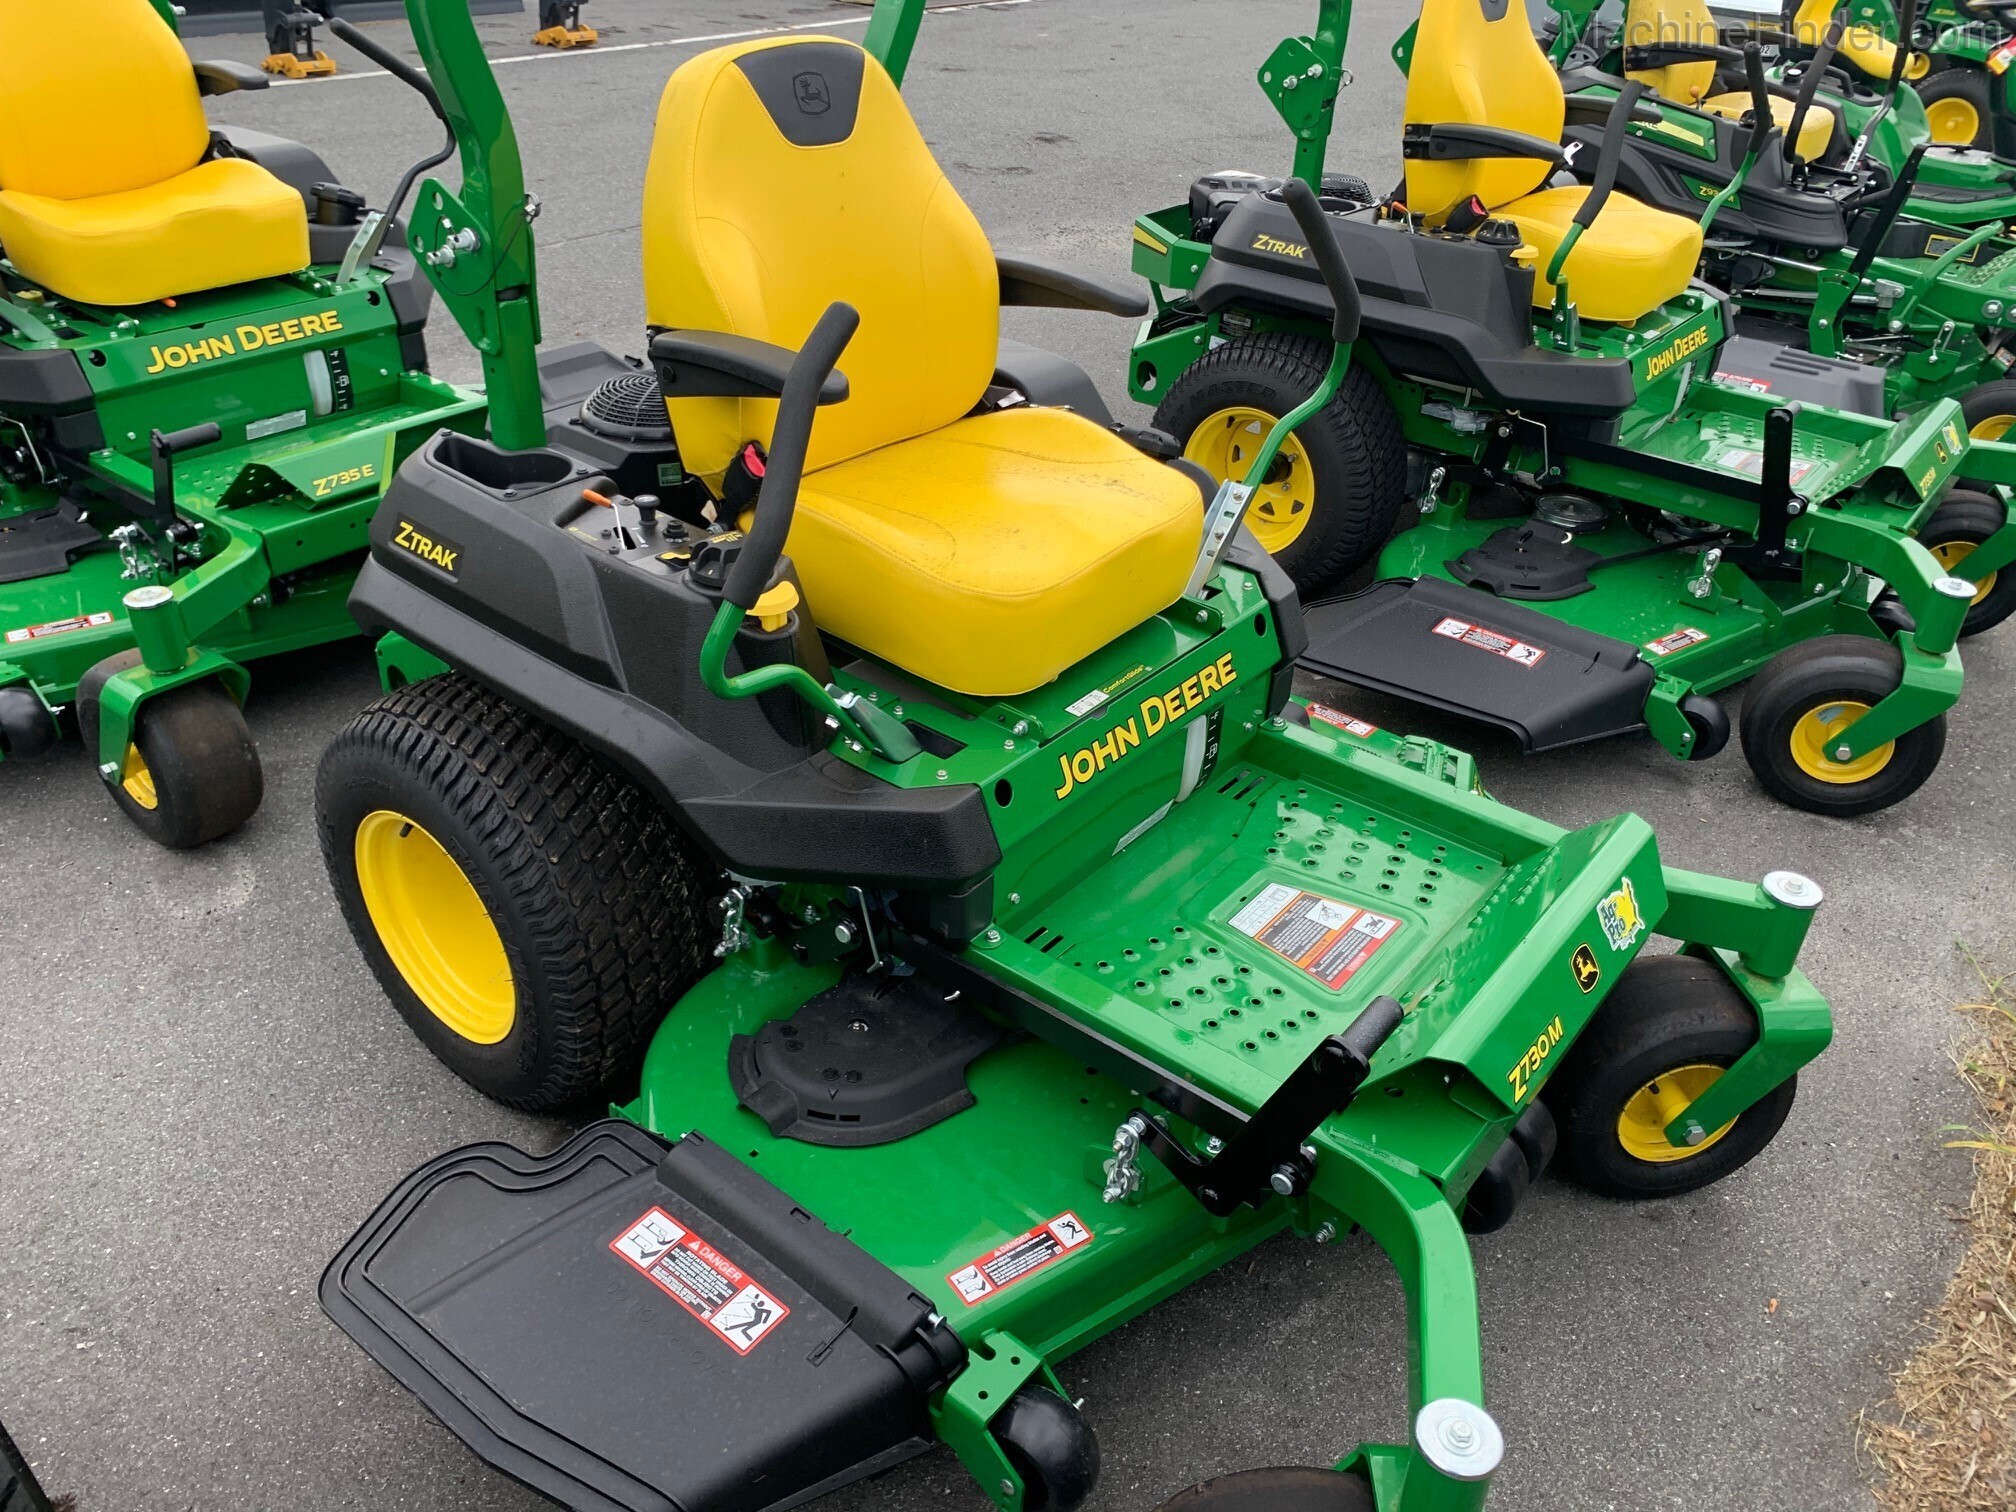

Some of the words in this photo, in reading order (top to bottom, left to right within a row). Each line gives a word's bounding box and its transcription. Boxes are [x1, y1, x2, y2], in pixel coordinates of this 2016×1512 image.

[1252, 233, 1308, 259] ZTRAK
[147, 335, 235, 374] JOHN
[237, 309, 343, 352] DEERE
[1646, 348, 1675, 381] JOHN
[1674, 327, 1708, 360] DEERE
[394, 521, 457, 571] ZTRAK
[1057, 717, 1140, 799] JOHN
[1140, 653, 1236, 737] DEERE
[698, 1245, 743, 1284] DANGER
[1000, 1231, 1032, 1253] DANGER
